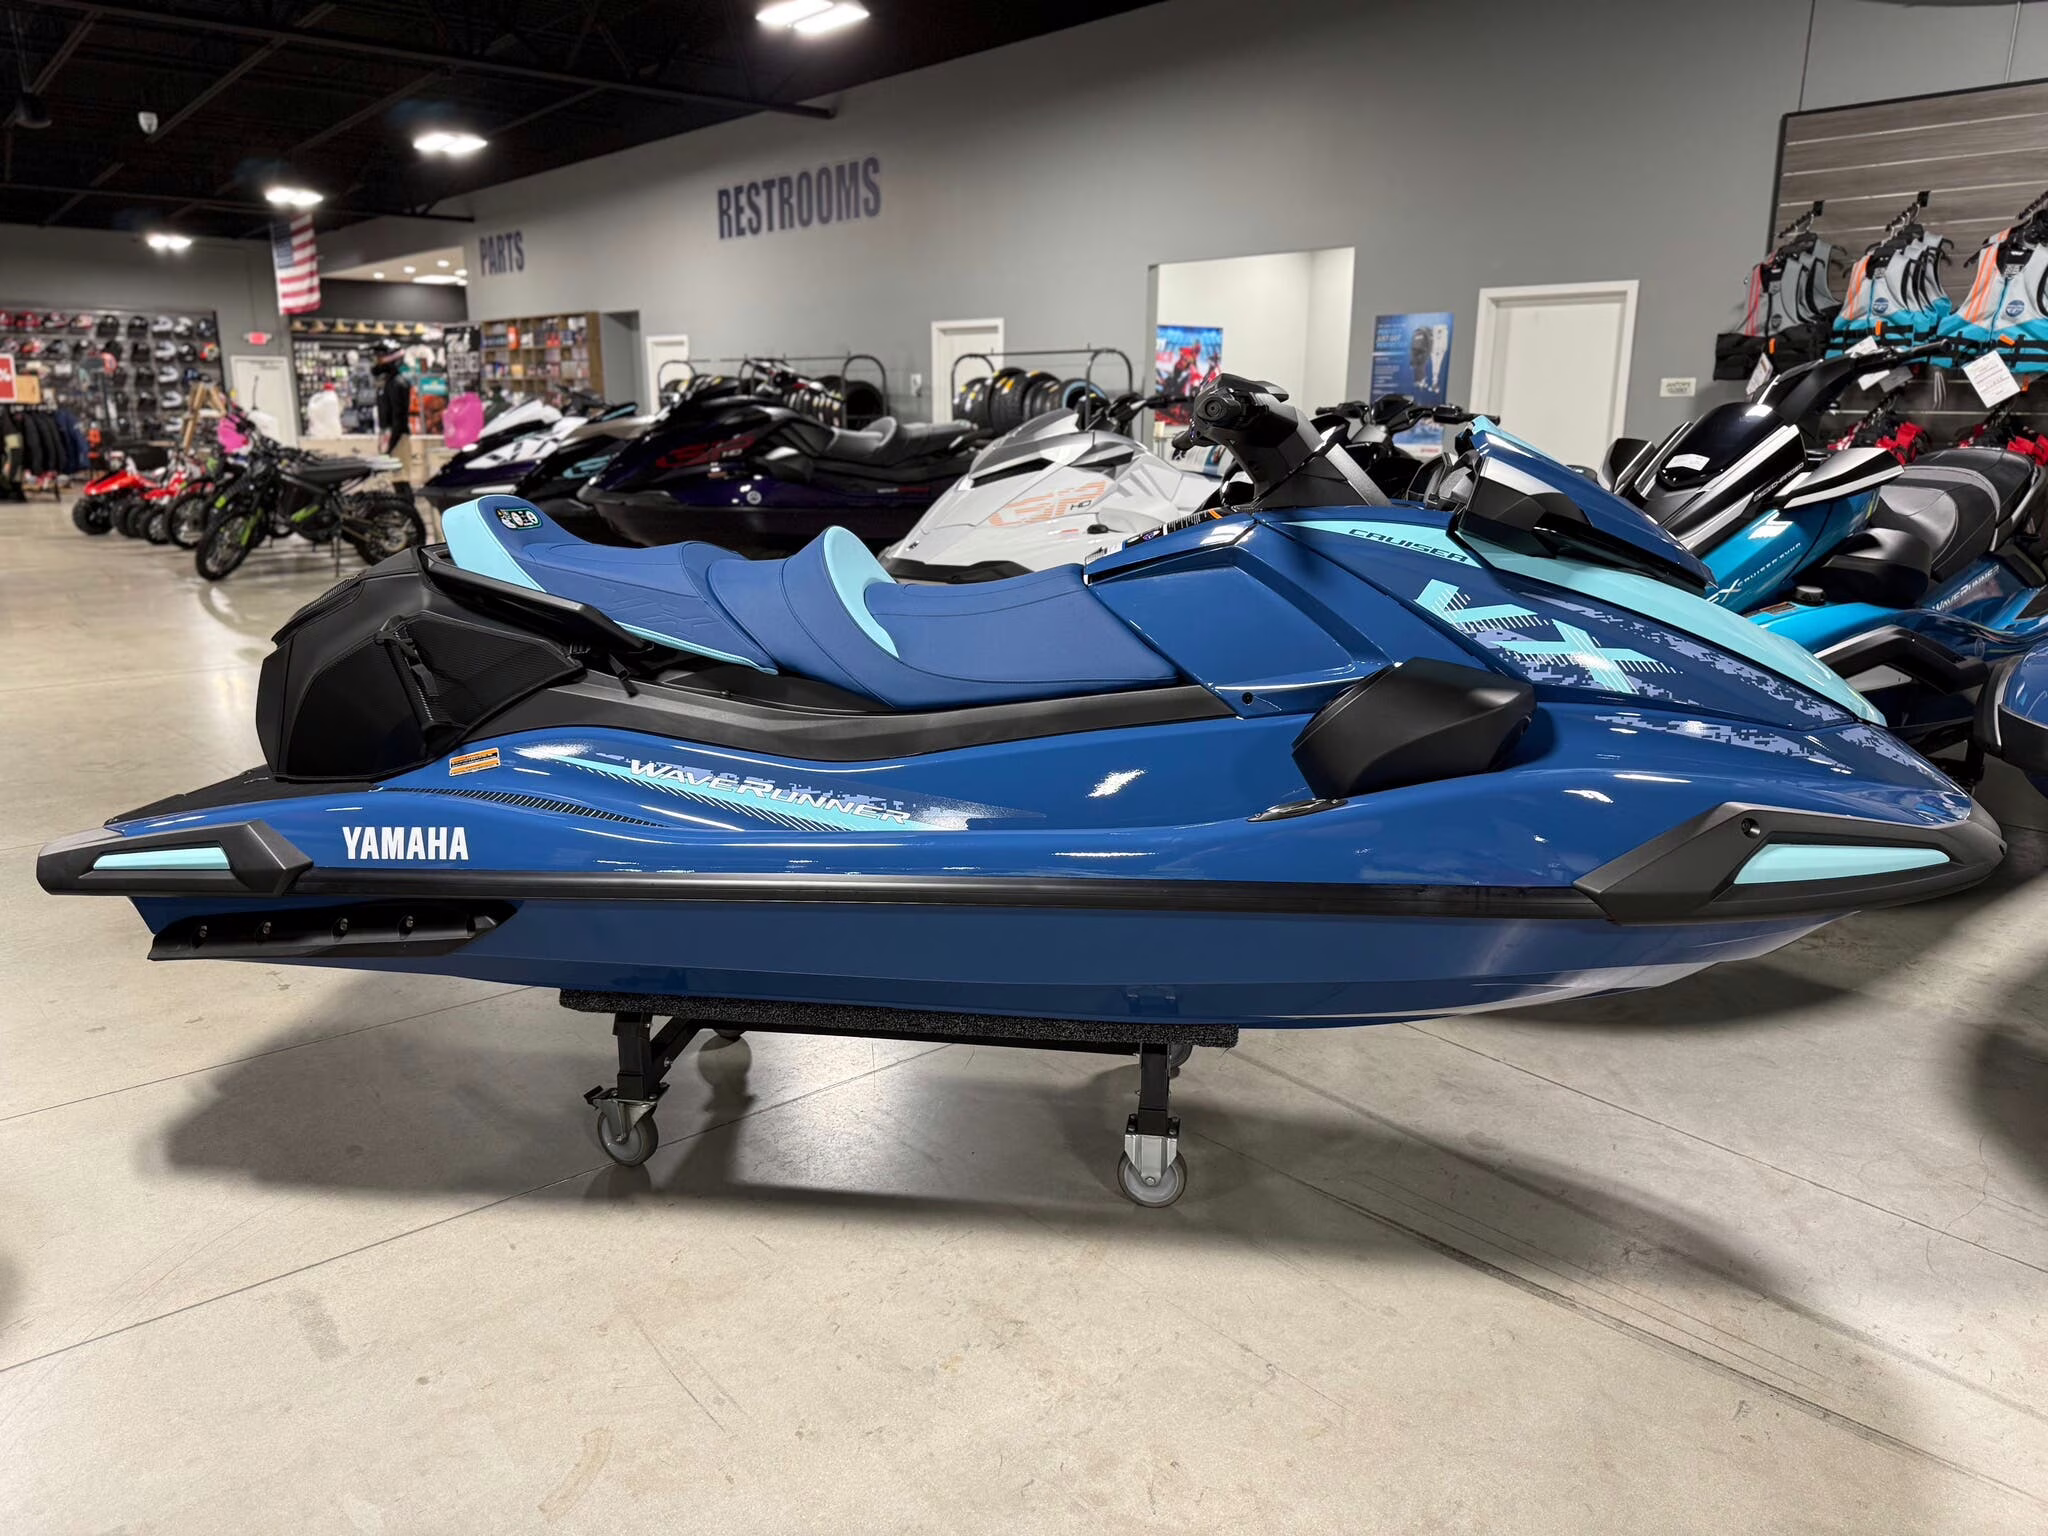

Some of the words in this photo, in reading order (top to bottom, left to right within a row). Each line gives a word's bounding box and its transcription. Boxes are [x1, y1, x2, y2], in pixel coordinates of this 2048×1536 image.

[717, 157, 881, 240] RESTROOMS
[479, 230, 525, 276] PARTS
[1349, 529, 1468, 563] CRUISER
[342, 826, 469, 861] YAMAHA
